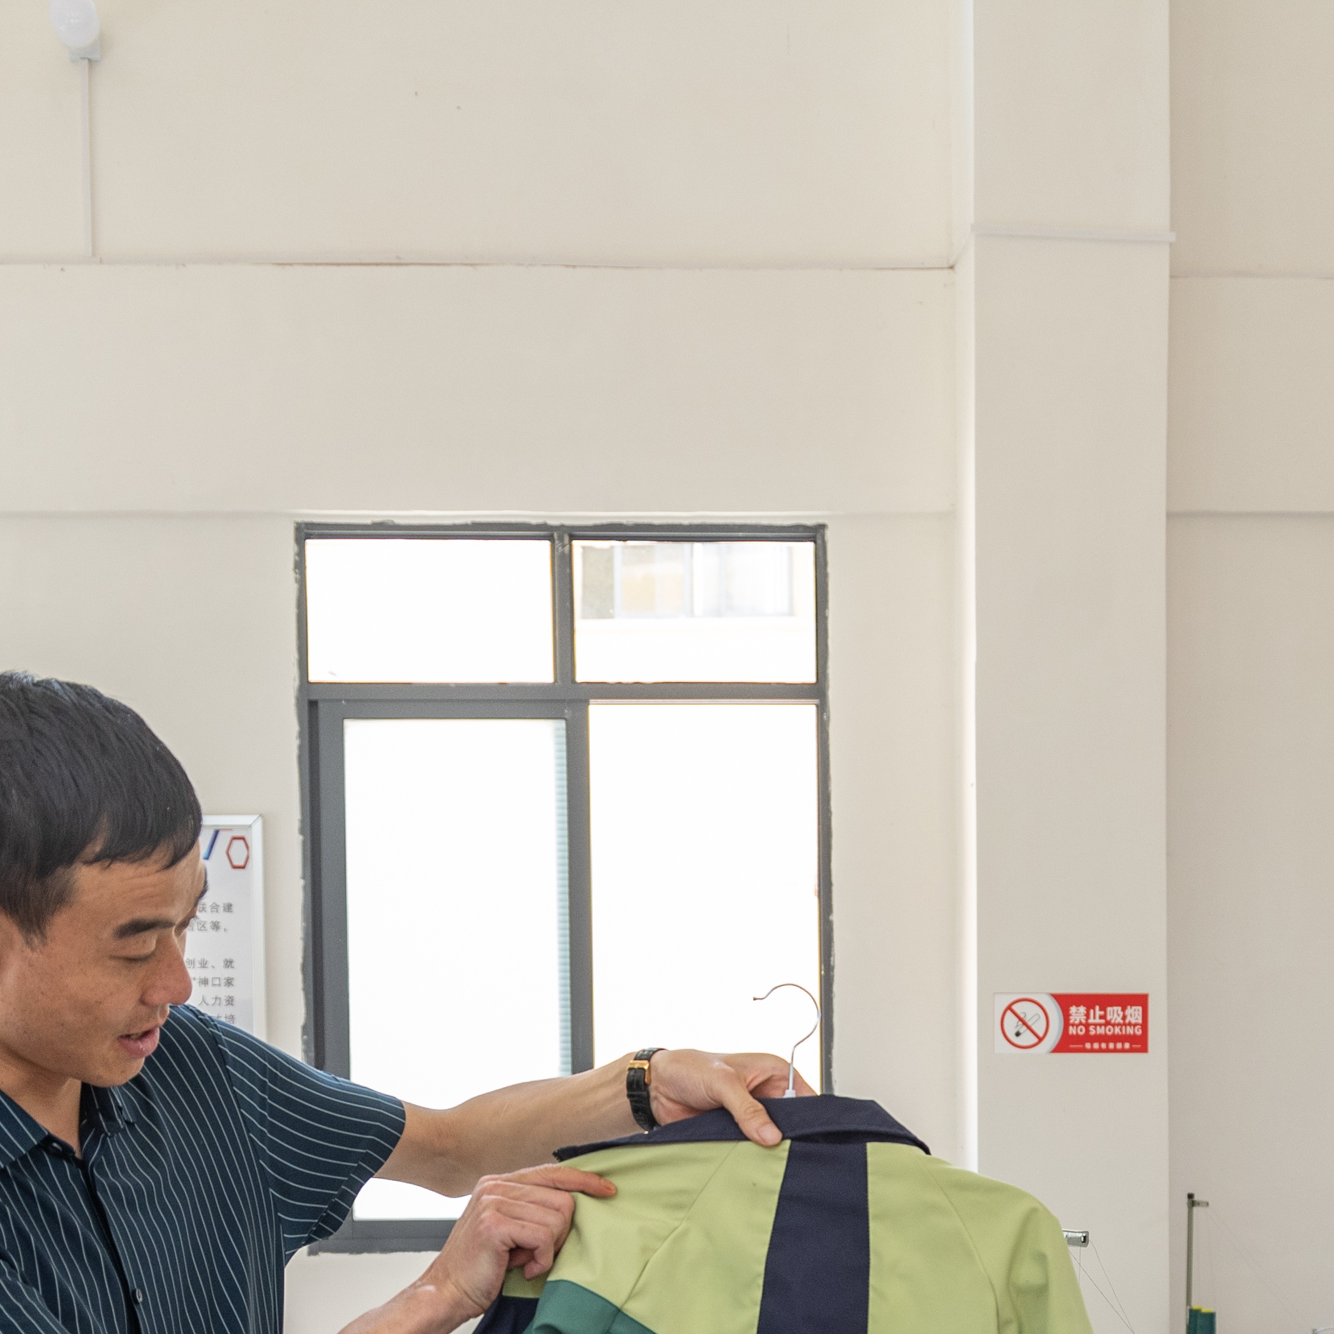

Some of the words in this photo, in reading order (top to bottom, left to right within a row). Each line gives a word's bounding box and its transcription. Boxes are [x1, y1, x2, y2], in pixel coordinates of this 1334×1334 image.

[198, 994, 234, 1006] 人力资
[1069, 1005, 1142, 1024] 禁止吸烟
[1068, 1025, 1086, 1035] NO
[1089, 1025, 1142, 1035] SMOKING
